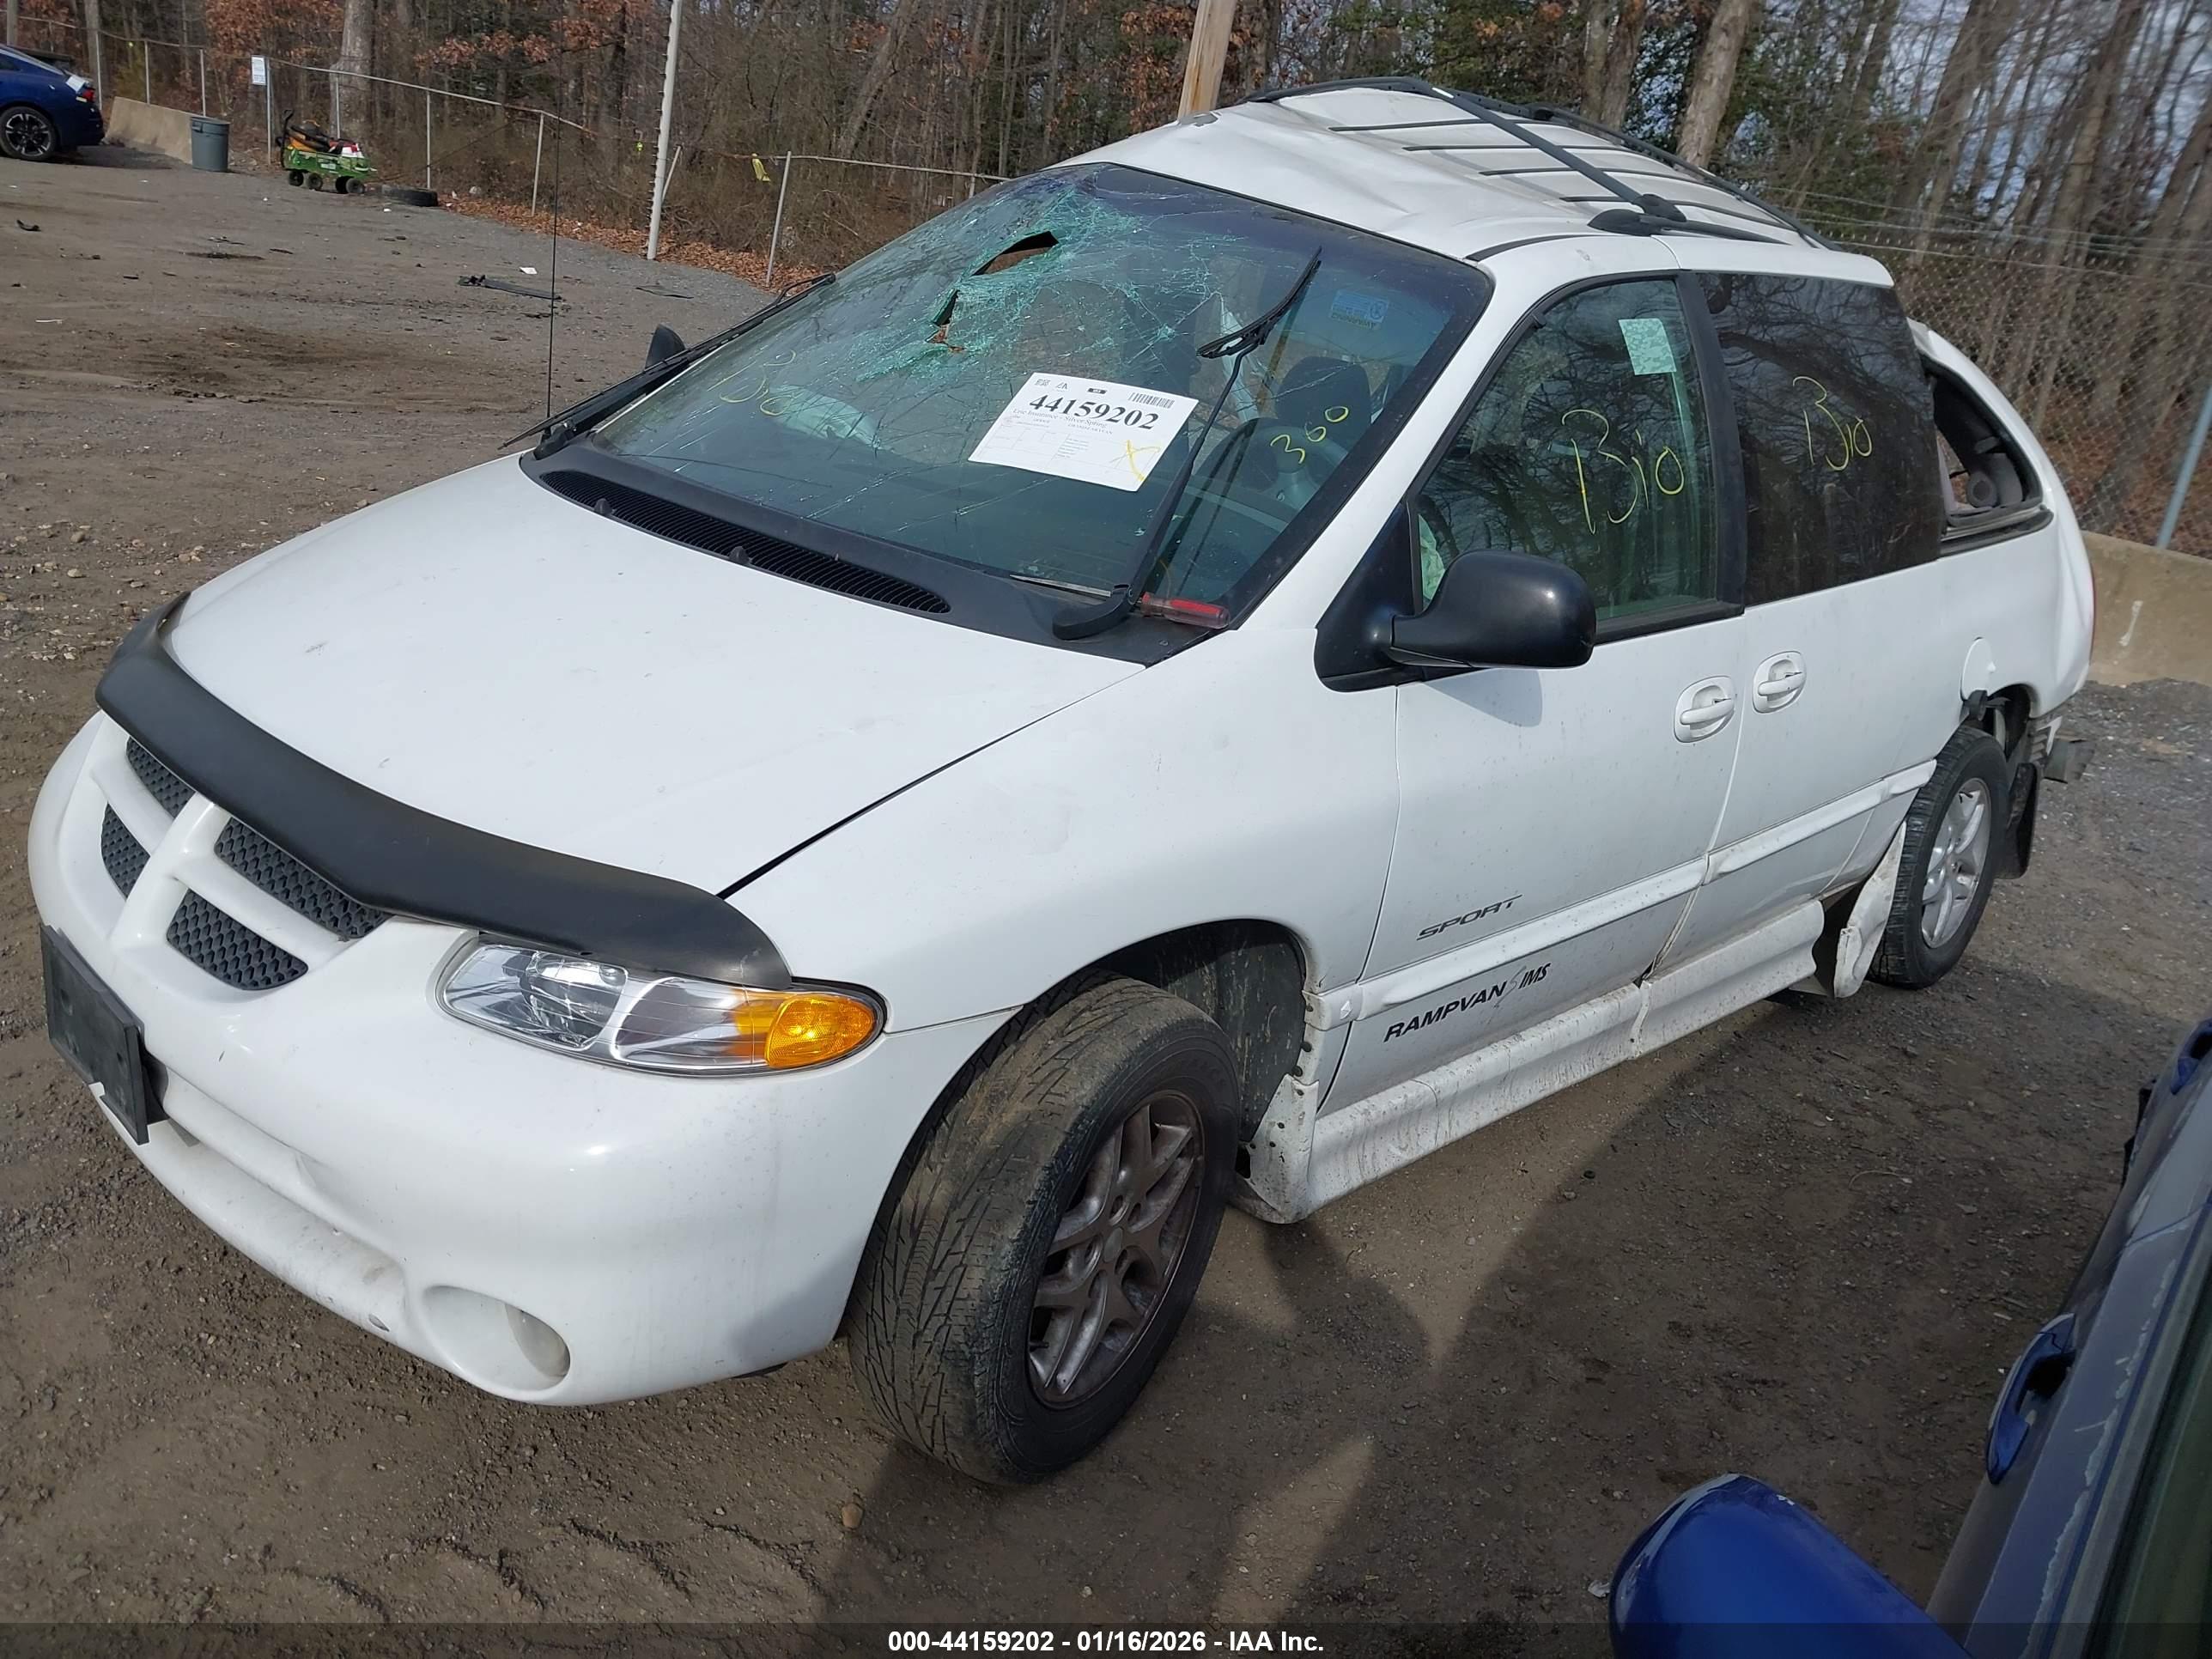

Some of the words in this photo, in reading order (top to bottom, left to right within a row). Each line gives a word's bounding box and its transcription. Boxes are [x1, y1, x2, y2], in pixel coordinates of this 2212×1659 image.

[1029, 394, 1159, 430] 44159202
[1416, 894, 1522, 941] SPORT
[1383, 981, 1507, 1042] RAMPVAN
